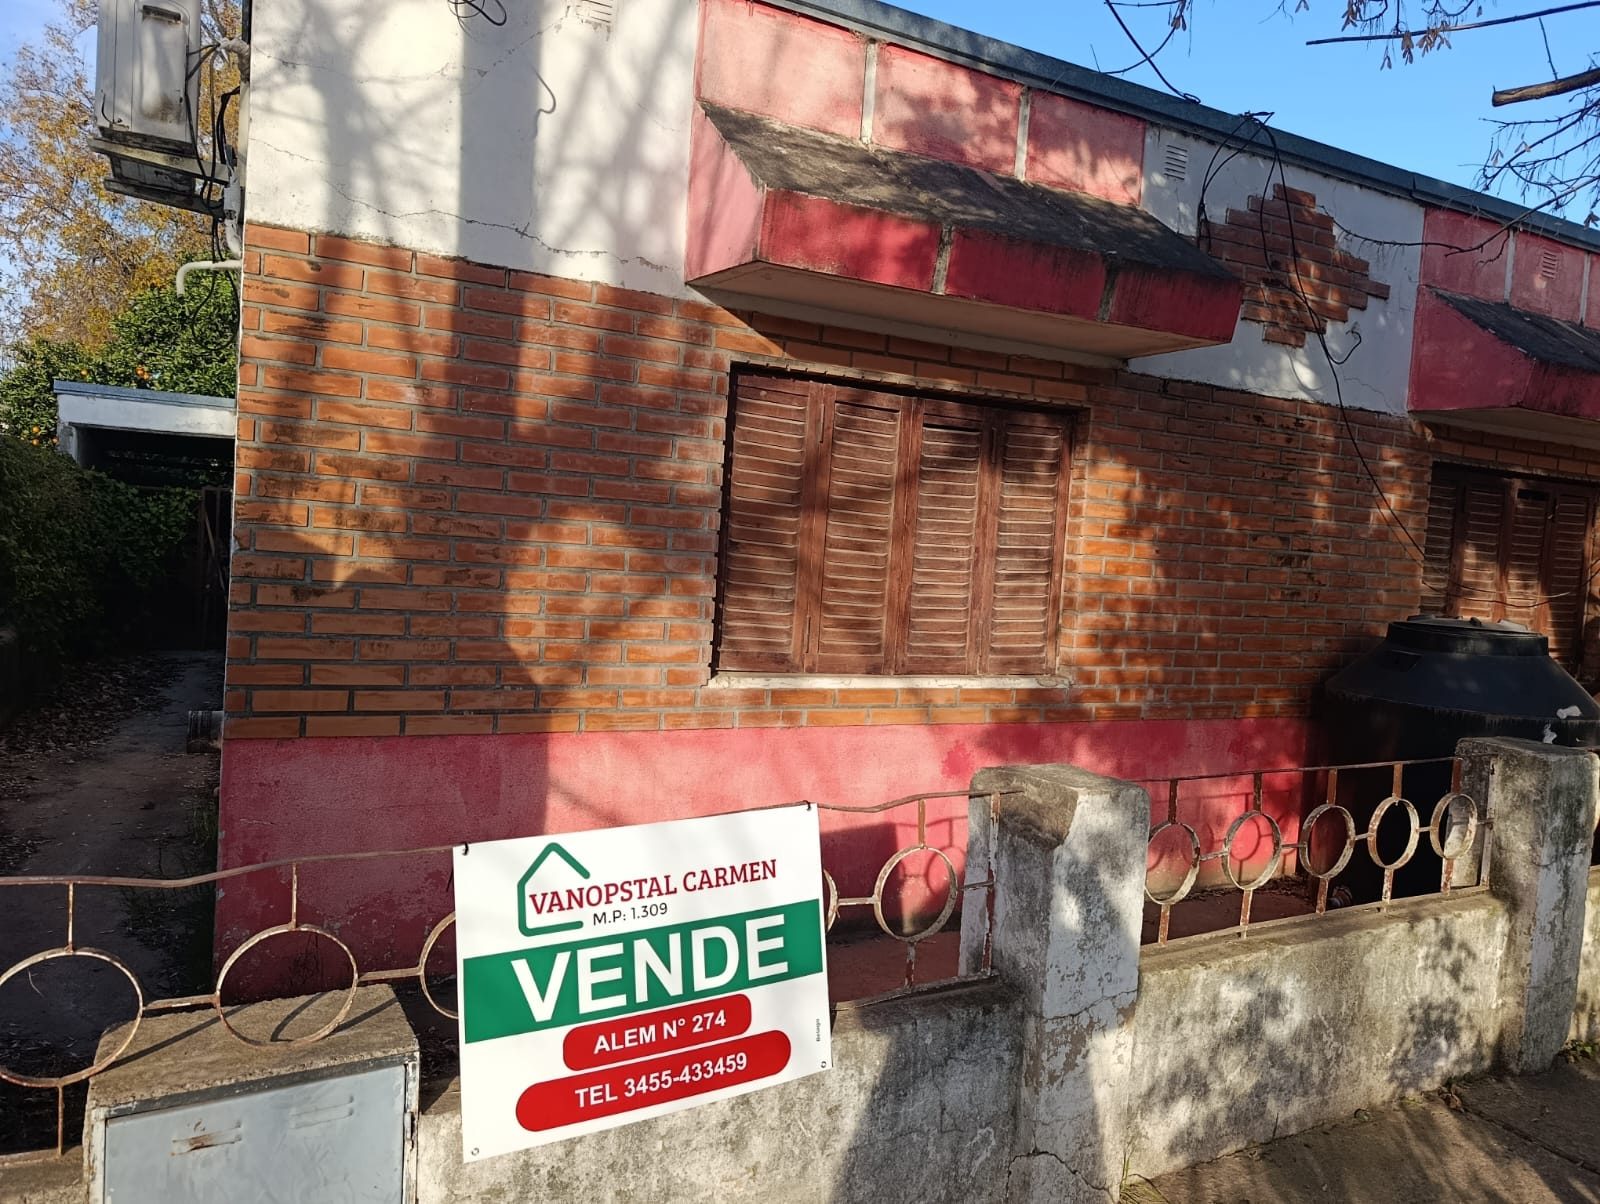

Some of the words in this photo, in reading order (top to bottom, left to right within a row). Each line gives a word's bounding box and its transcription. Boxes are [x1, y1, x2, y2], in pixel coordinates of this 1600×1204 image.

[529, 874, 678, 915] VANOPSTAL
[682, 859, 778, 892] CARMEN
[592, 908, 627, 926] M.P:
[631, 902, 669, 920] 1.309
[510, 913, 789, 1023] VENDE
[593, 1023, 657, 1055] ALEM
[692, 1009, 727, 1033] 274
[575, 1083, 618, 1108] TEL
[623, 1052, 748, 1097] 3455-433459
